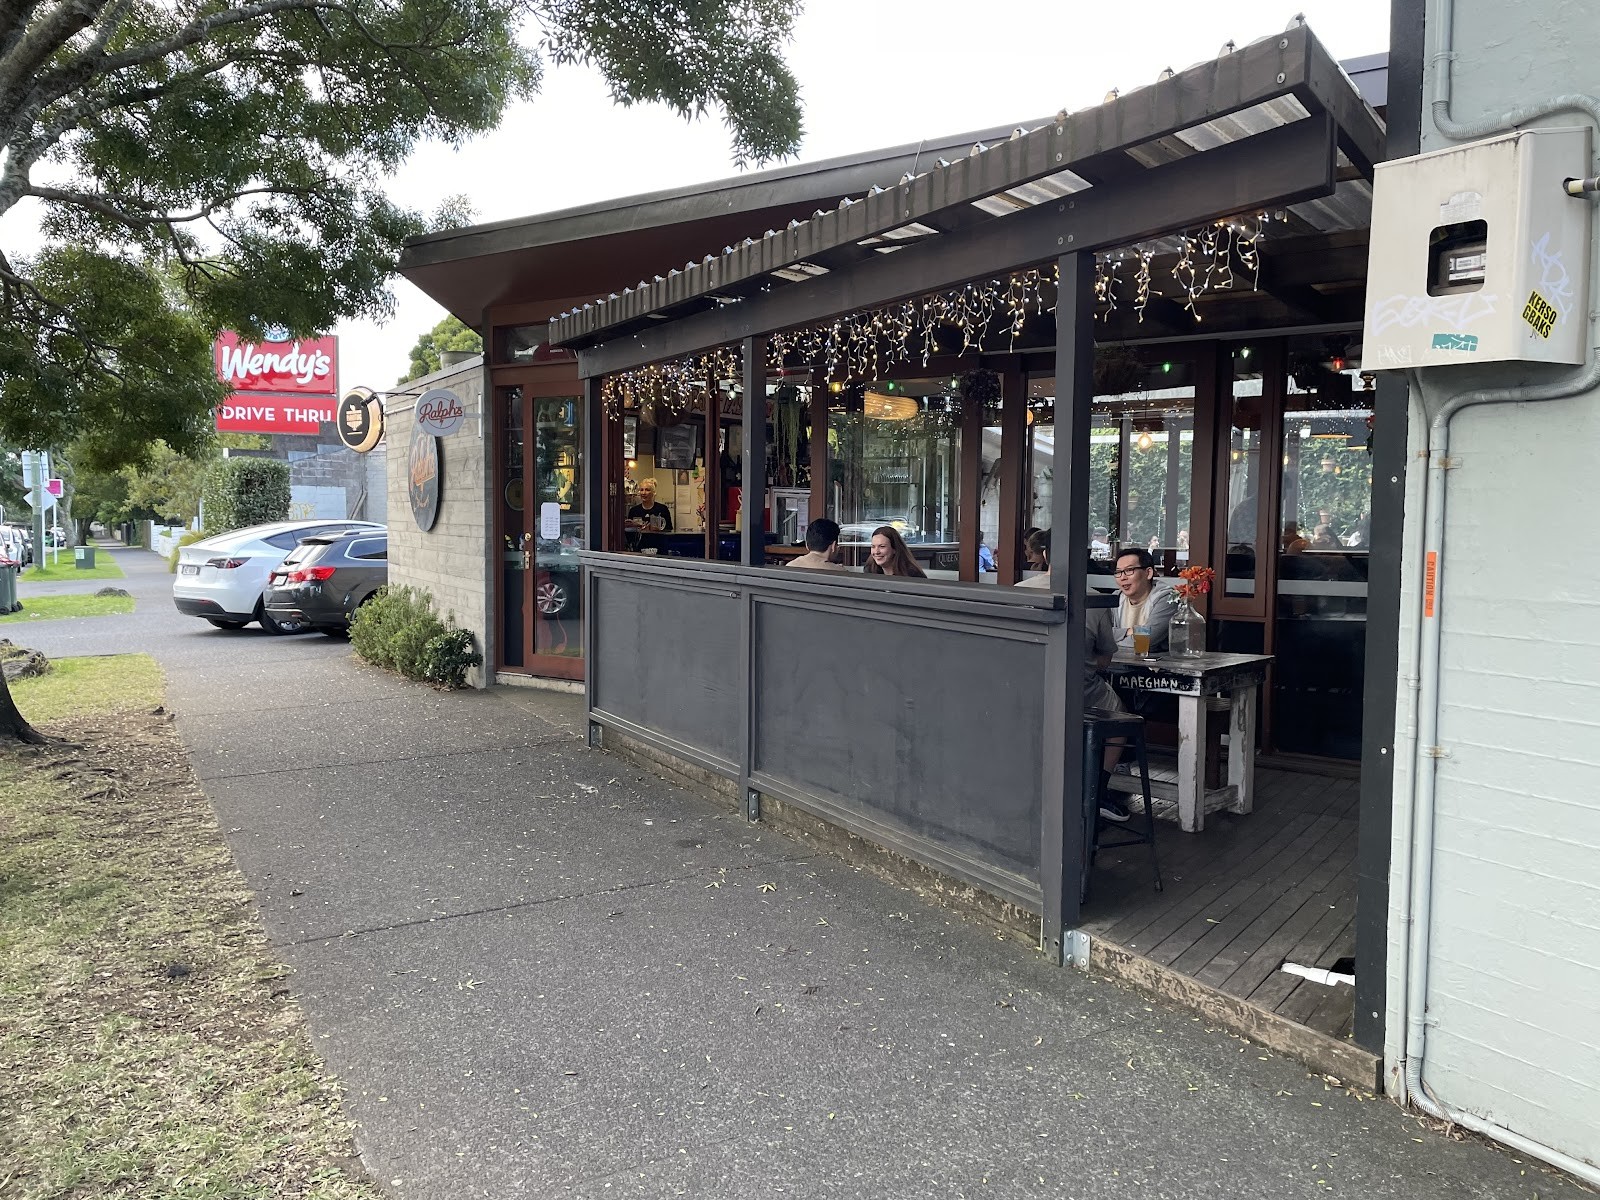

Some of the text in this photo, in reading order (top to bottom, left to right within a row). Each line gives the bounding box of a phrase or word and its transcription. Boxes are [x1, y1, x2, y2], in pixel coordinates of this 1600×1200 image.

[1522, 304, 1551, 338] GBAKS
[1528, 291, 1557, 325] KERSO
[222, 342, 331, 384] Wendy's
[222, 406, 332, 423] DRIVE THRU
[419, 399, 463, 423] Ralph's
[1426, 561, 1435, 596] CAUTION
[1119, 675, 1178, 690] MAEGHAN
